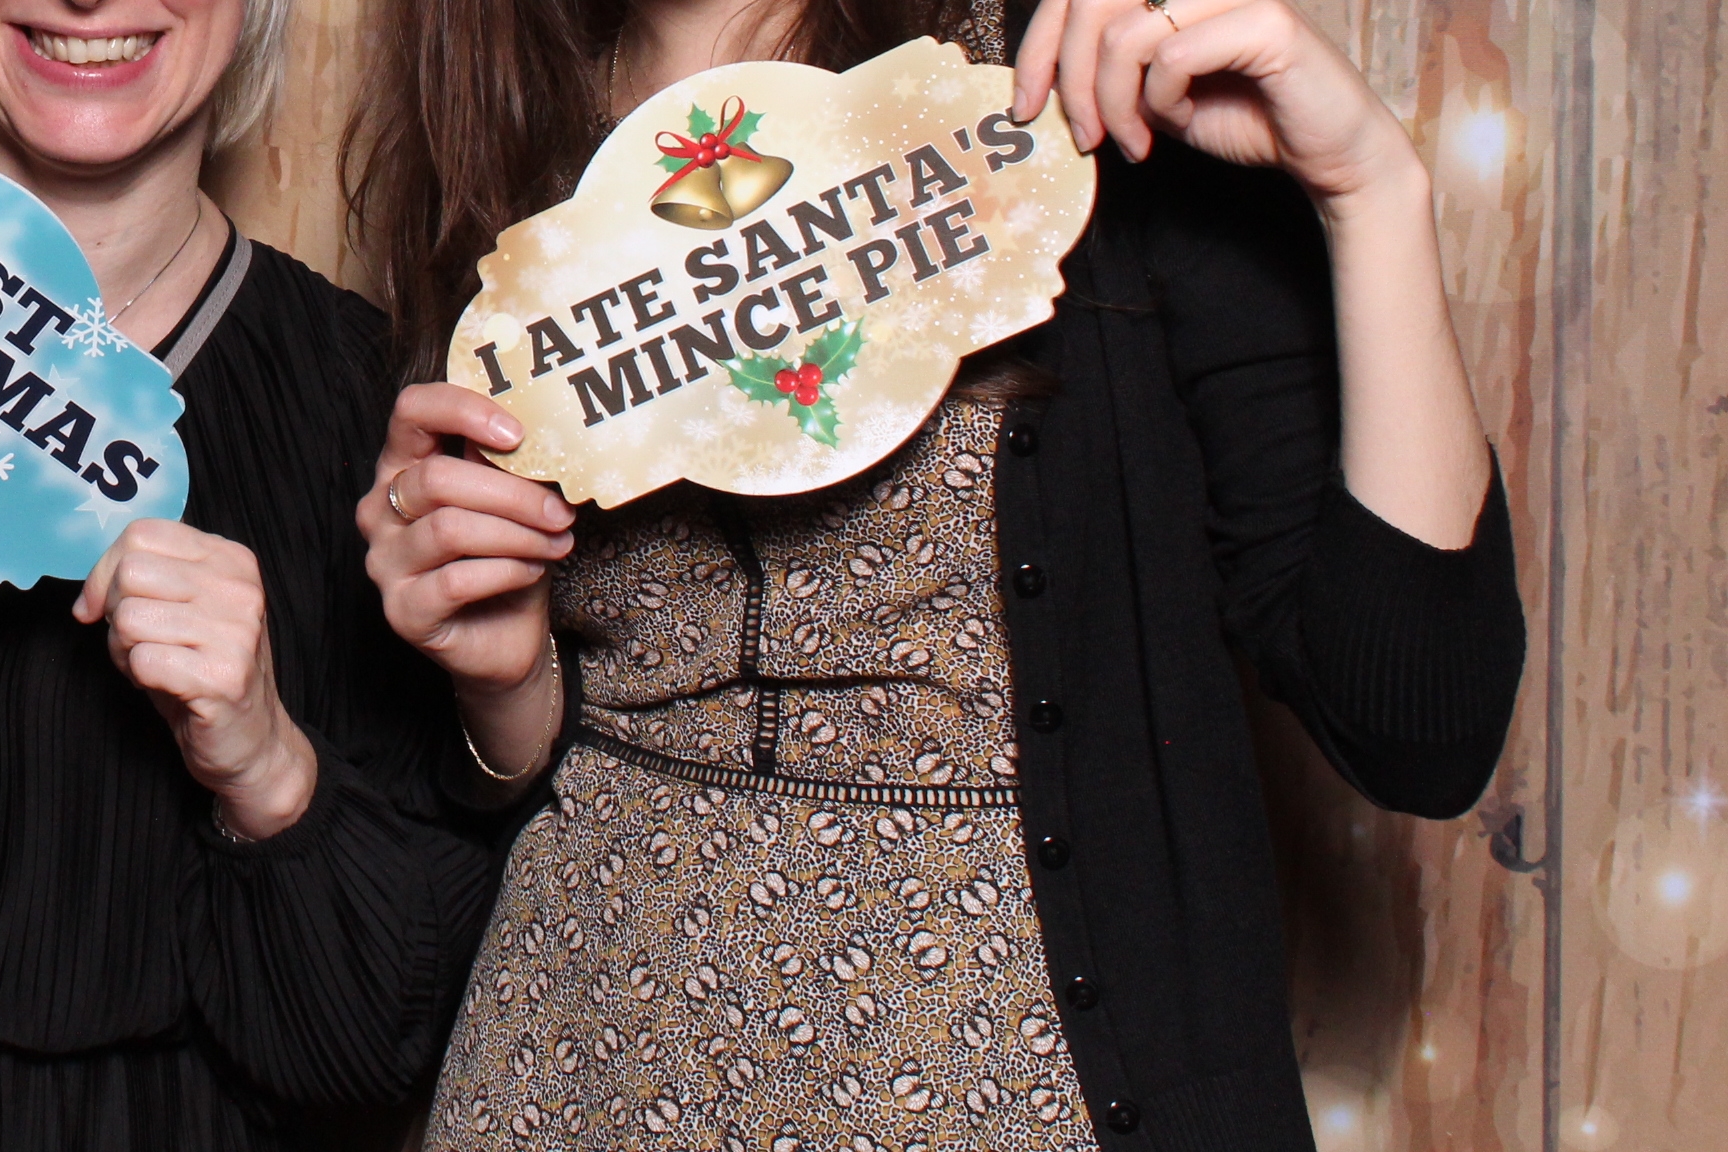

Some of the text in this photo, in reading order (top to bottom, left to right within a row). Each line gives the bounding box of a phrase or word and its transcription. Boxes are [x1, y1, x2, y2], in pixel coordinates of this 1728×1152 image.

[474, 106, 1035, 397] I ATE SANTA'S
[568, 199, 990, 428] MINCE PIE
